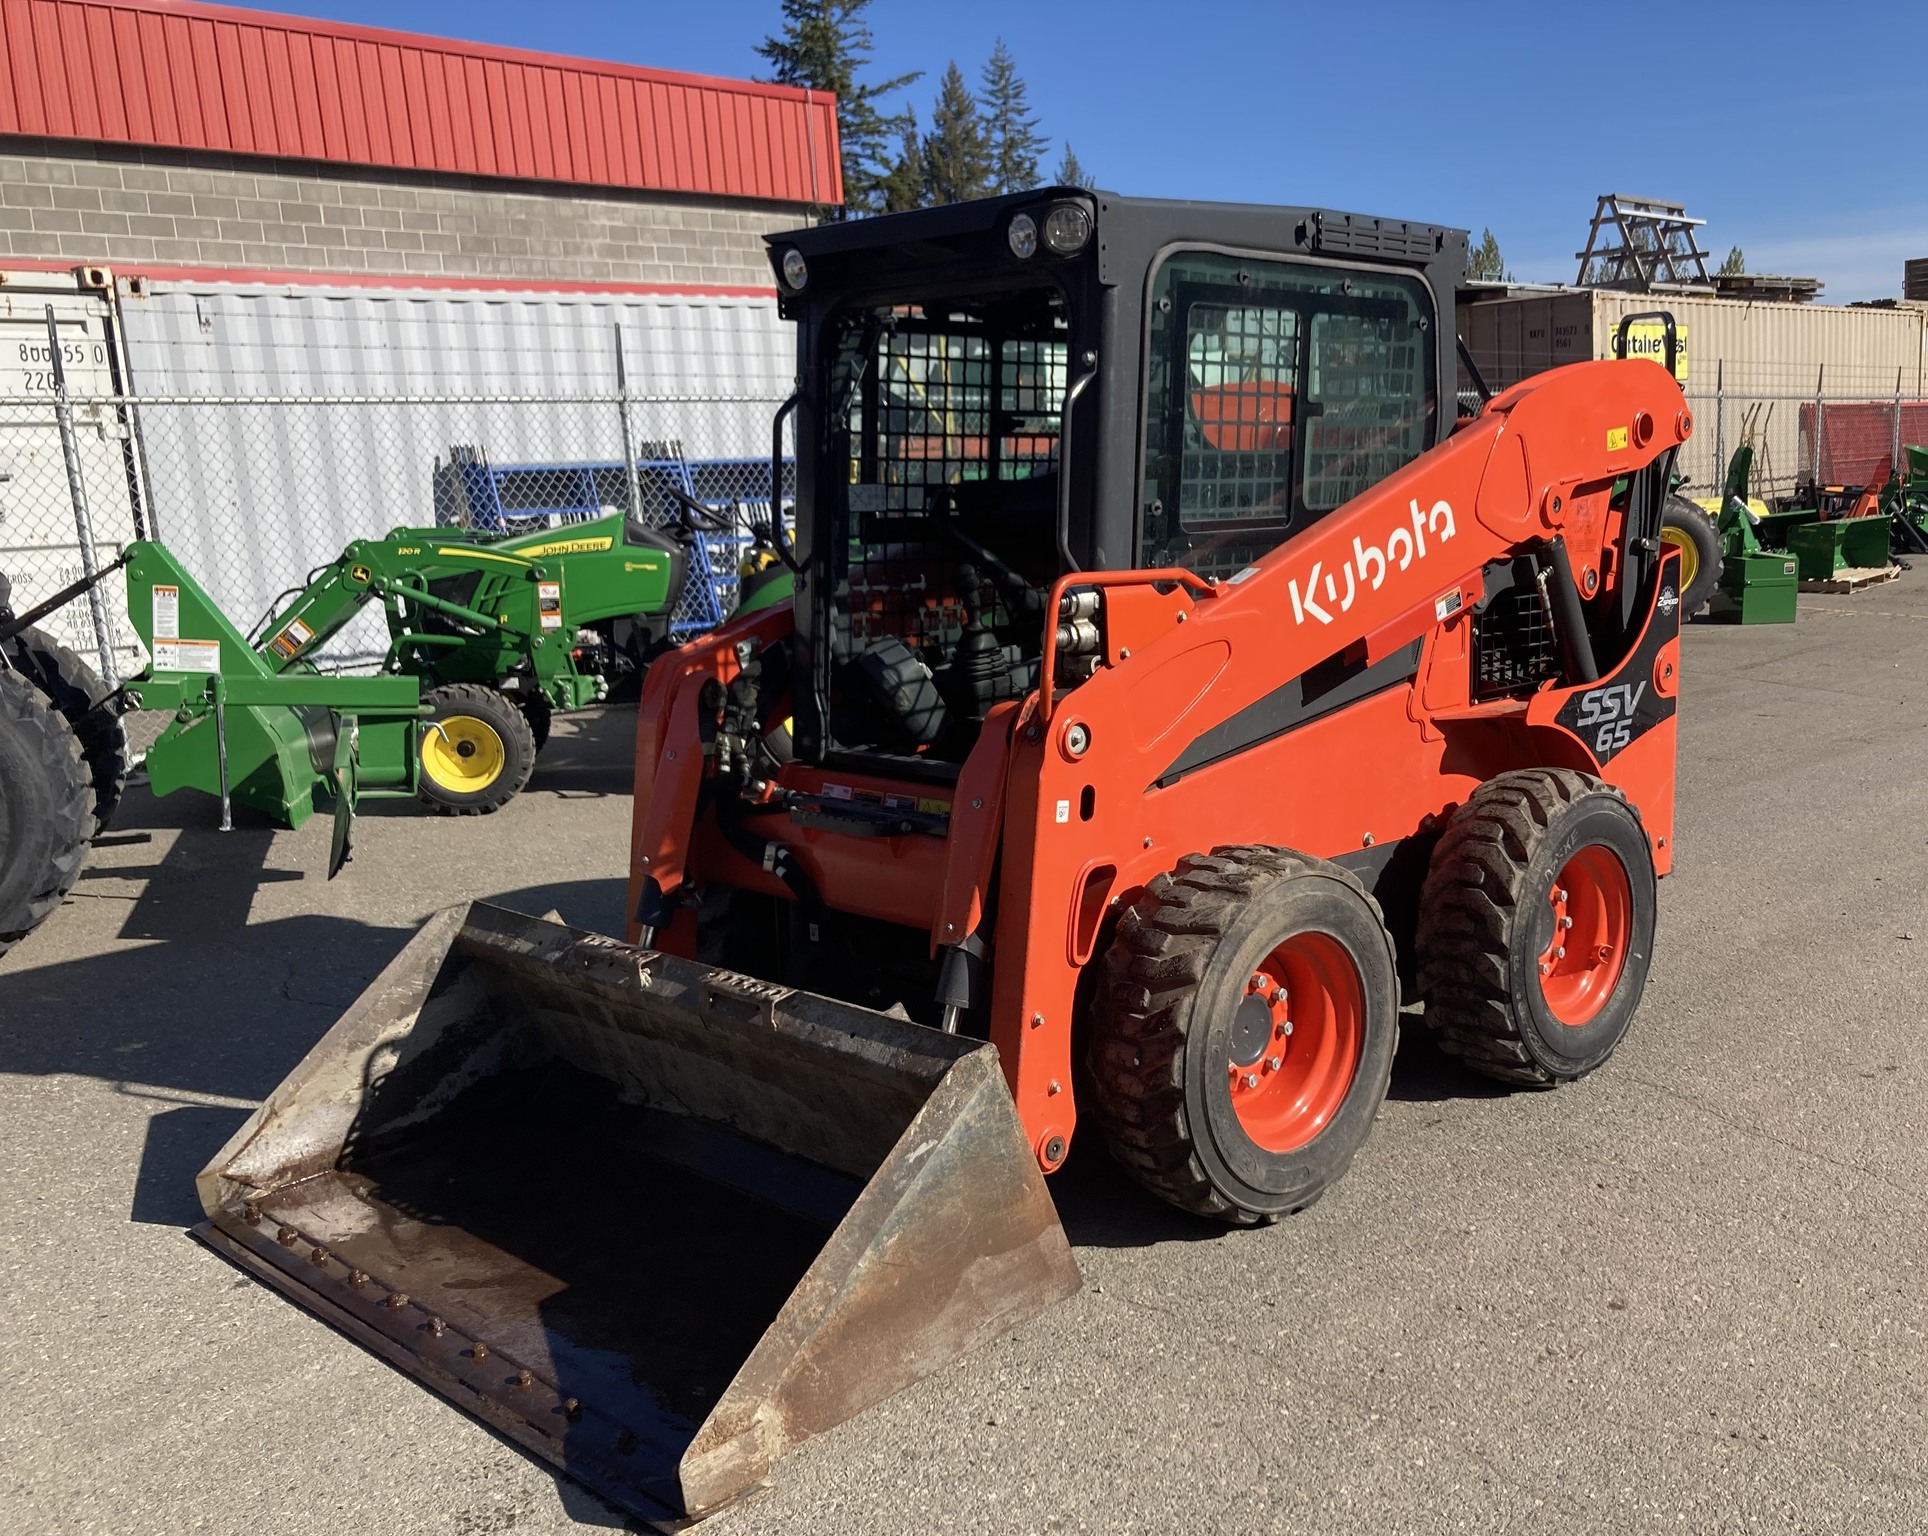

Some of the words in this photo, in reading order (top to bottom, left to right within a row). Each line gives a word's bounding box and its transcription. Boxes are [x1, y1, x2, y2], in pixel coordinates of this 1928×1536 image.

[19, 343, 84, 363] 80055
[94, 344, 104, 364] 0
[24, 372, 56, 390] 22G
[541, 546, 569, 556] JOHN
[571, 541, 607, 552] DEERE
[1288, 498, 1456, 625] Kubota
[1577, 681, 1647, 727] SSV
[1596, 719, 1632, 752] 65
